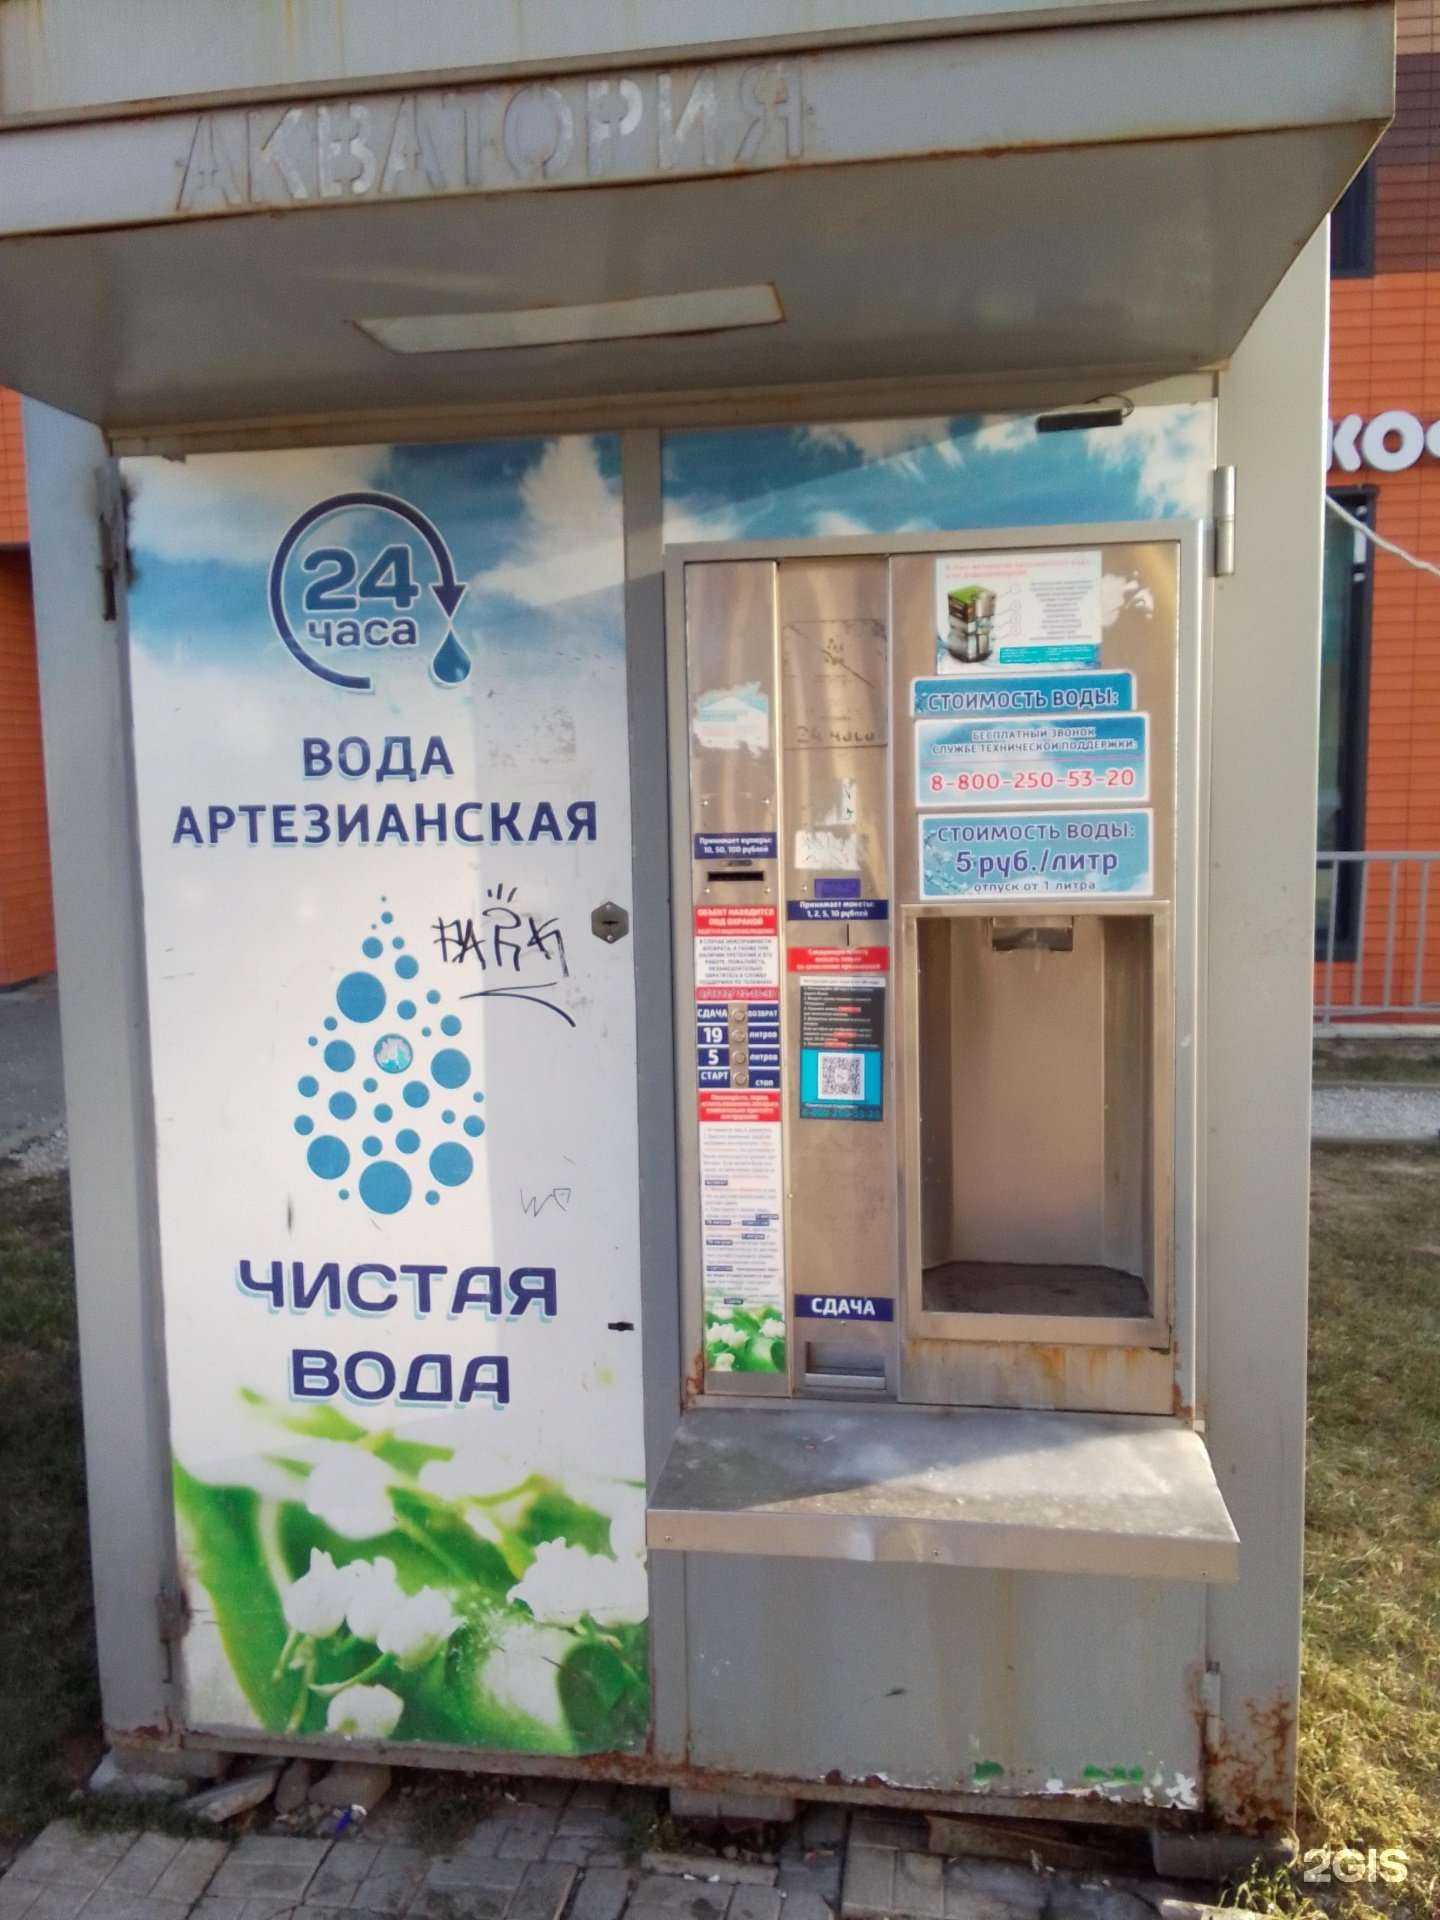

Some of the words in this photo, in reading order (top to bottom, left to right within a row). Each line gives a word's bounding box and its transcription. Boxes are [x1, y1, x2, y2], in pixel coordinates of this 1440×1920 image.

[175, 63, 804, 209] АКВАТОРИЯ
[303, 545, 419, 611] 24
[308, 618, 417, 646] часа
[928, 691, 1048, 711] СТОИМОСТЬ
[1053, 688, 1119, 708] ВОДЫ:
[972, 728, 1048, 741] БЕСПЛАТНЫЙ
[1051, 727, 1095, 738] ЗВОНОК
[932, 743, 977, 754] СЛУЖБЕ
[981, 741, 1059, 753] ТЕХНИЧЕСКОЙ
[302, 736, 454, 782] ВОДА
[931, 769, 1134, 791] 8-800-250-53-20
[172, 801, 597, 844] АРТЕЗИАНСКАЯ
[938, 824, 1060, 841] СТОИМОСТЬ
[1067, 823, 1135, 840] ВОДЫ:
[956, 851, 971, 872] 5
[979, 850, 1118, 877] руб./литр
[974, 882, 1019, 893] отпуск
[1023, 883, 1038, 891] от
[1044, 881, 1049, 890] 1
[1055, 881, 1096, 891] литра
[697, 1009, 728, 1018] СДАЧА
[703, 1027, 723, 1043] 19
[749, 1032, 777, 1040] литров
[708, 1049, 719, 1065] 5
[749, 1054, 778, 1062] литров
[700, 1072, 728, 1080] СТАРТ
[238, 1259, 557, 1317] ЧИСТАЯ
[811, 1297, 876, 1316] СДАЧА
[291, 1349, 510, 1404] ВОДА
